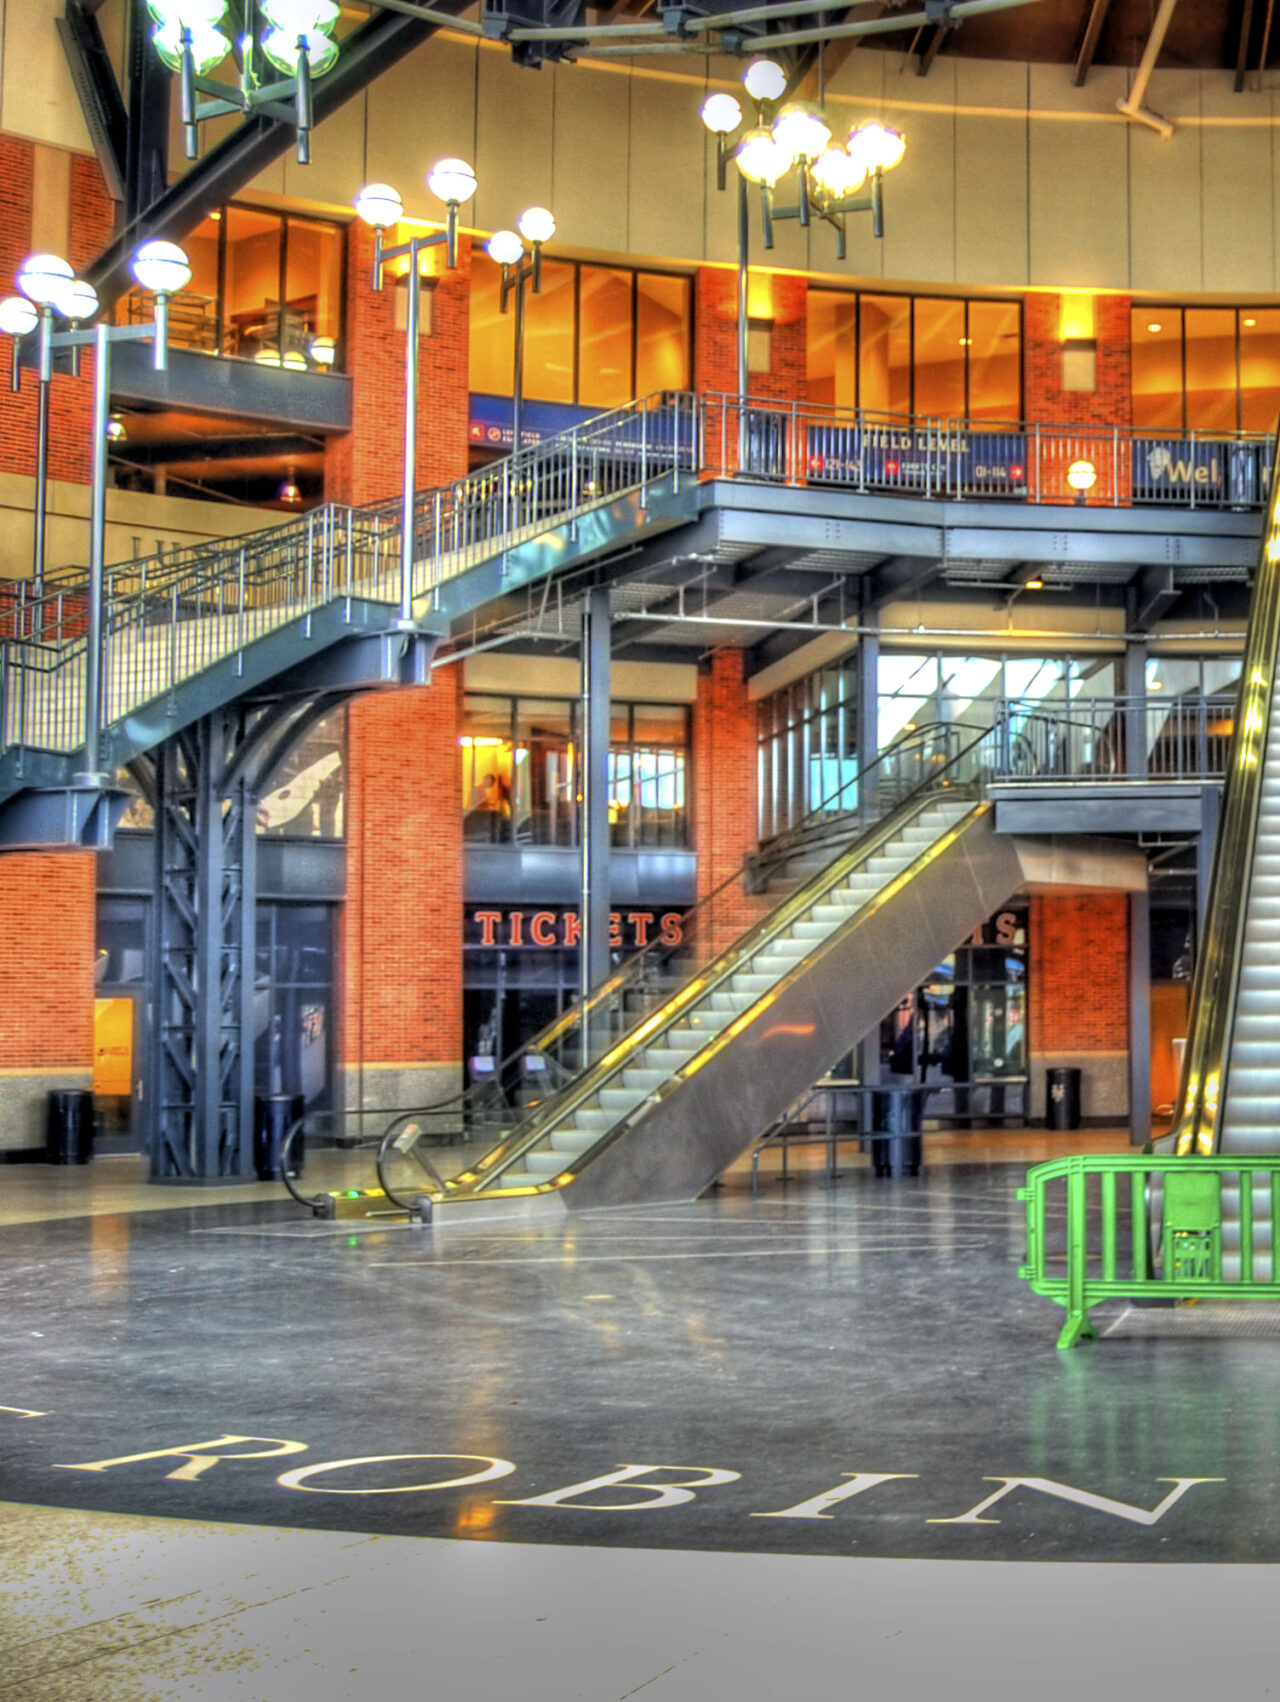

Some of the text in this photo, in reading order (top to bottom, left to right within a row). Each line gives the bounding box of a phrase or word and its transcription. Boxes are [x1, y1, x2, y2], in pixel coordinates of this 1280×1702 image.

[862, 433, 970, 453] FIELD LEVEL
[475, 912, 684, 947] TICKETS
